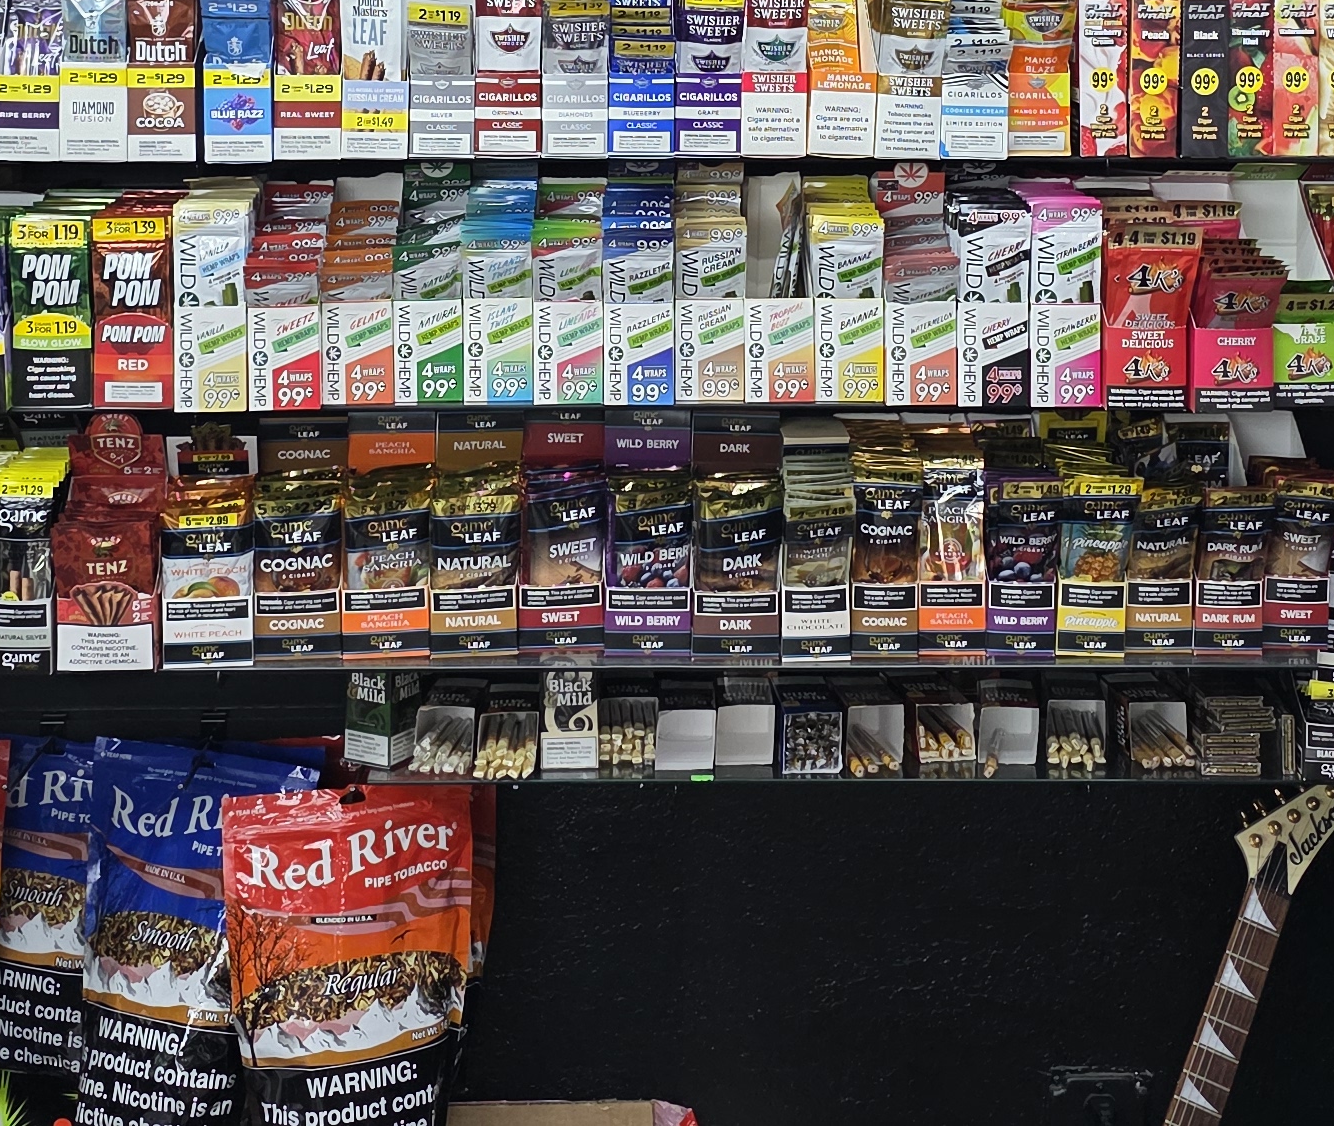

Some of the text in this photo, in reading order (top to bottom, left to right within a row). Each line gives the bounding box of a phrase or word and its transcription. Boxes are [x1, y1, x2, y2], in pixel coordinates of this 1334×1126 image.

[353, 17, 387, 45] LEAF
[1141, 29, 1170, 42] Peach
[136, 42, 186, 62] Dutch
[818, 81, 871, 90] LEMONADE
[826, 75, 862, 83] MANGO
[478, 92, 537, 102] CIGARILLOS
[72, 101, 114, 115] DIAMOND
[136, 116, 185, 129] COCOA
[23, 255, 71, 280] POM
[30, 281, 78, 305] POM
[1131, 331, 1165, 340] SWEET
[1217, 337, 1256, 346] CHERRY
[1122, 339, 1174, 348] DELICIOUS
[118, 359, 149, 370] RED
[278, 385, 313, 408] 99¢
[97, 437, 136, 450] TENZ
[260, 553, 333, 572] COGNAC
[722, 555, 762, 572] DARK
[557, 691, 592, 706] Mild
[249, 819, 454, 892] Red River
[364, 859, 448, 889] PIPE TOBACCO
[131, 920, 193, 952] Smooth
[306, 1061, 418, 1099] WARNING:
